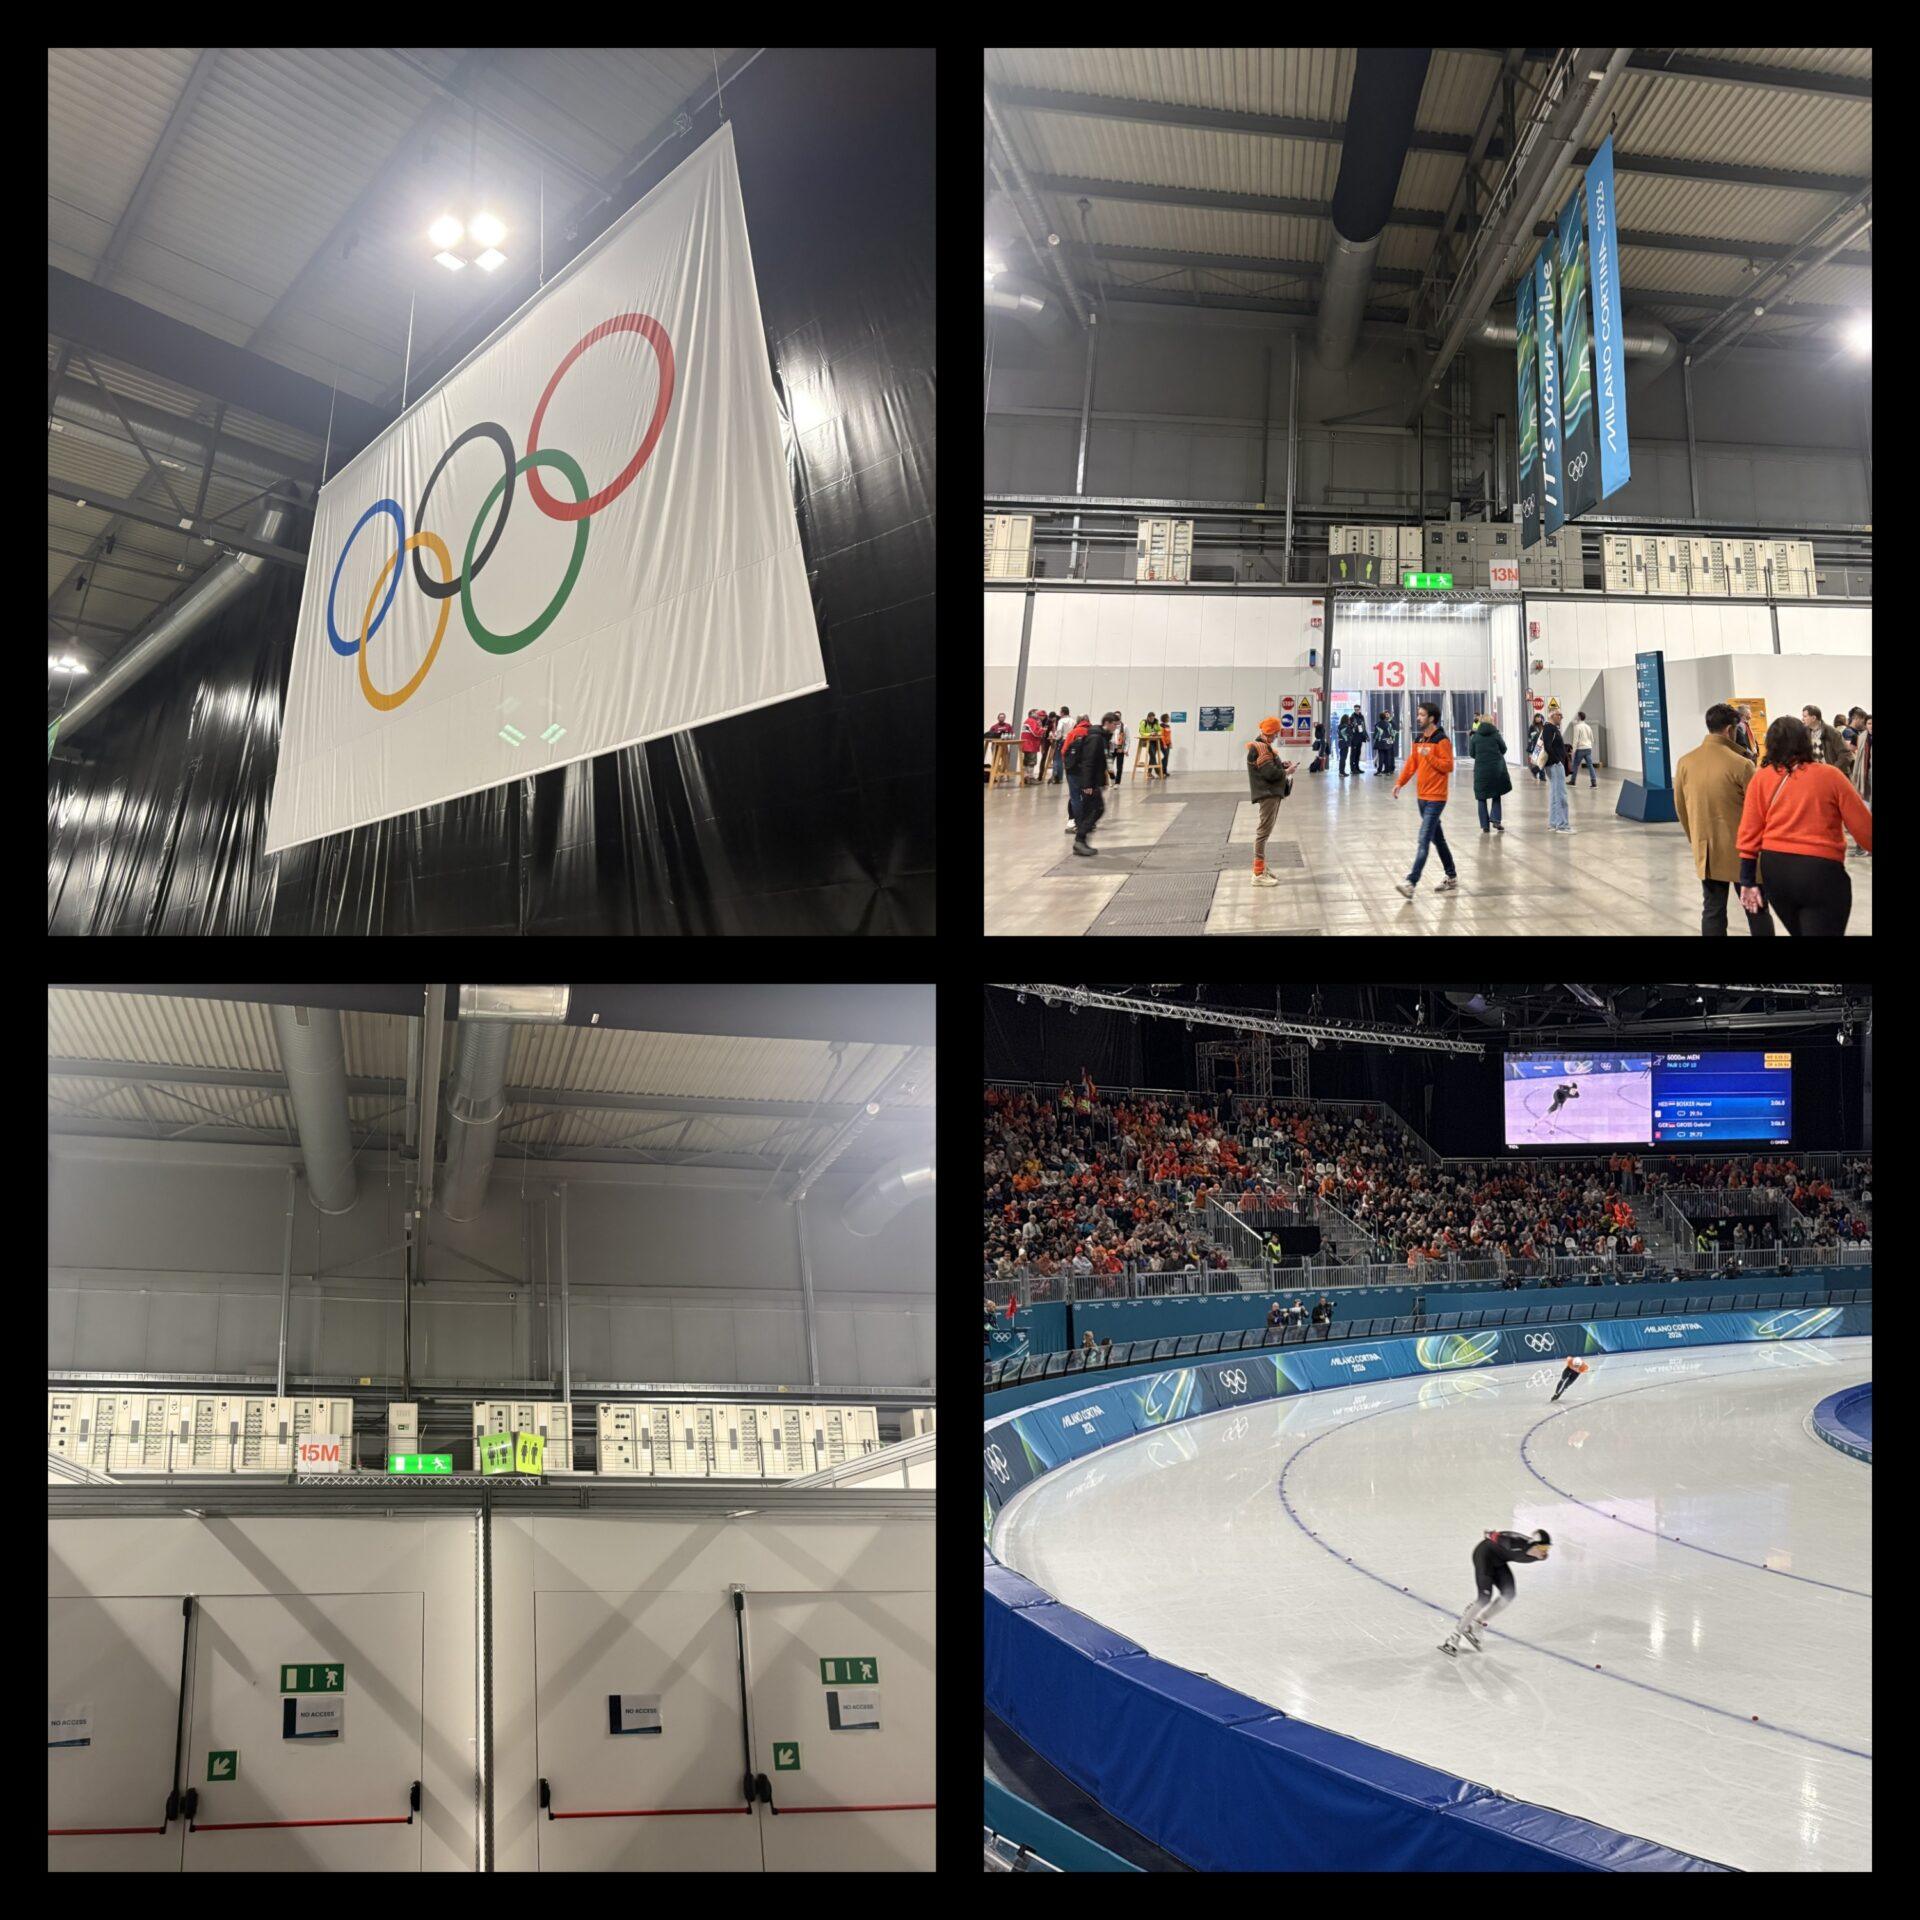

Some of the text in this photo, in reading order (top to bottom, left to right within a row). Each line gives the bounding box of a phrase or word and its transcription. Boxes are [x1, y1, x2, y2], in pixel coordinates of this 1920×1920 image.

[1539, 259, 1554, 332] vibe
[1596, 180, 1617, 453] MILANO CORTINA 2026
[1543, 339, 1557, 428] your
[1491, 567, 1519, 581] 13N
[1372, 661, 1441, 688] 13 N
[1643, 1322, 1703, 1334] MILANO CORTINA
[1667, 1331, 1683, 1339] 2026
[1330, 1353, 1382, 1366] MILANO CORTINA
[1061, 1404, 1105, 1429] MILANO CORTINA
[299, 1444, 339, 1461] 15M
